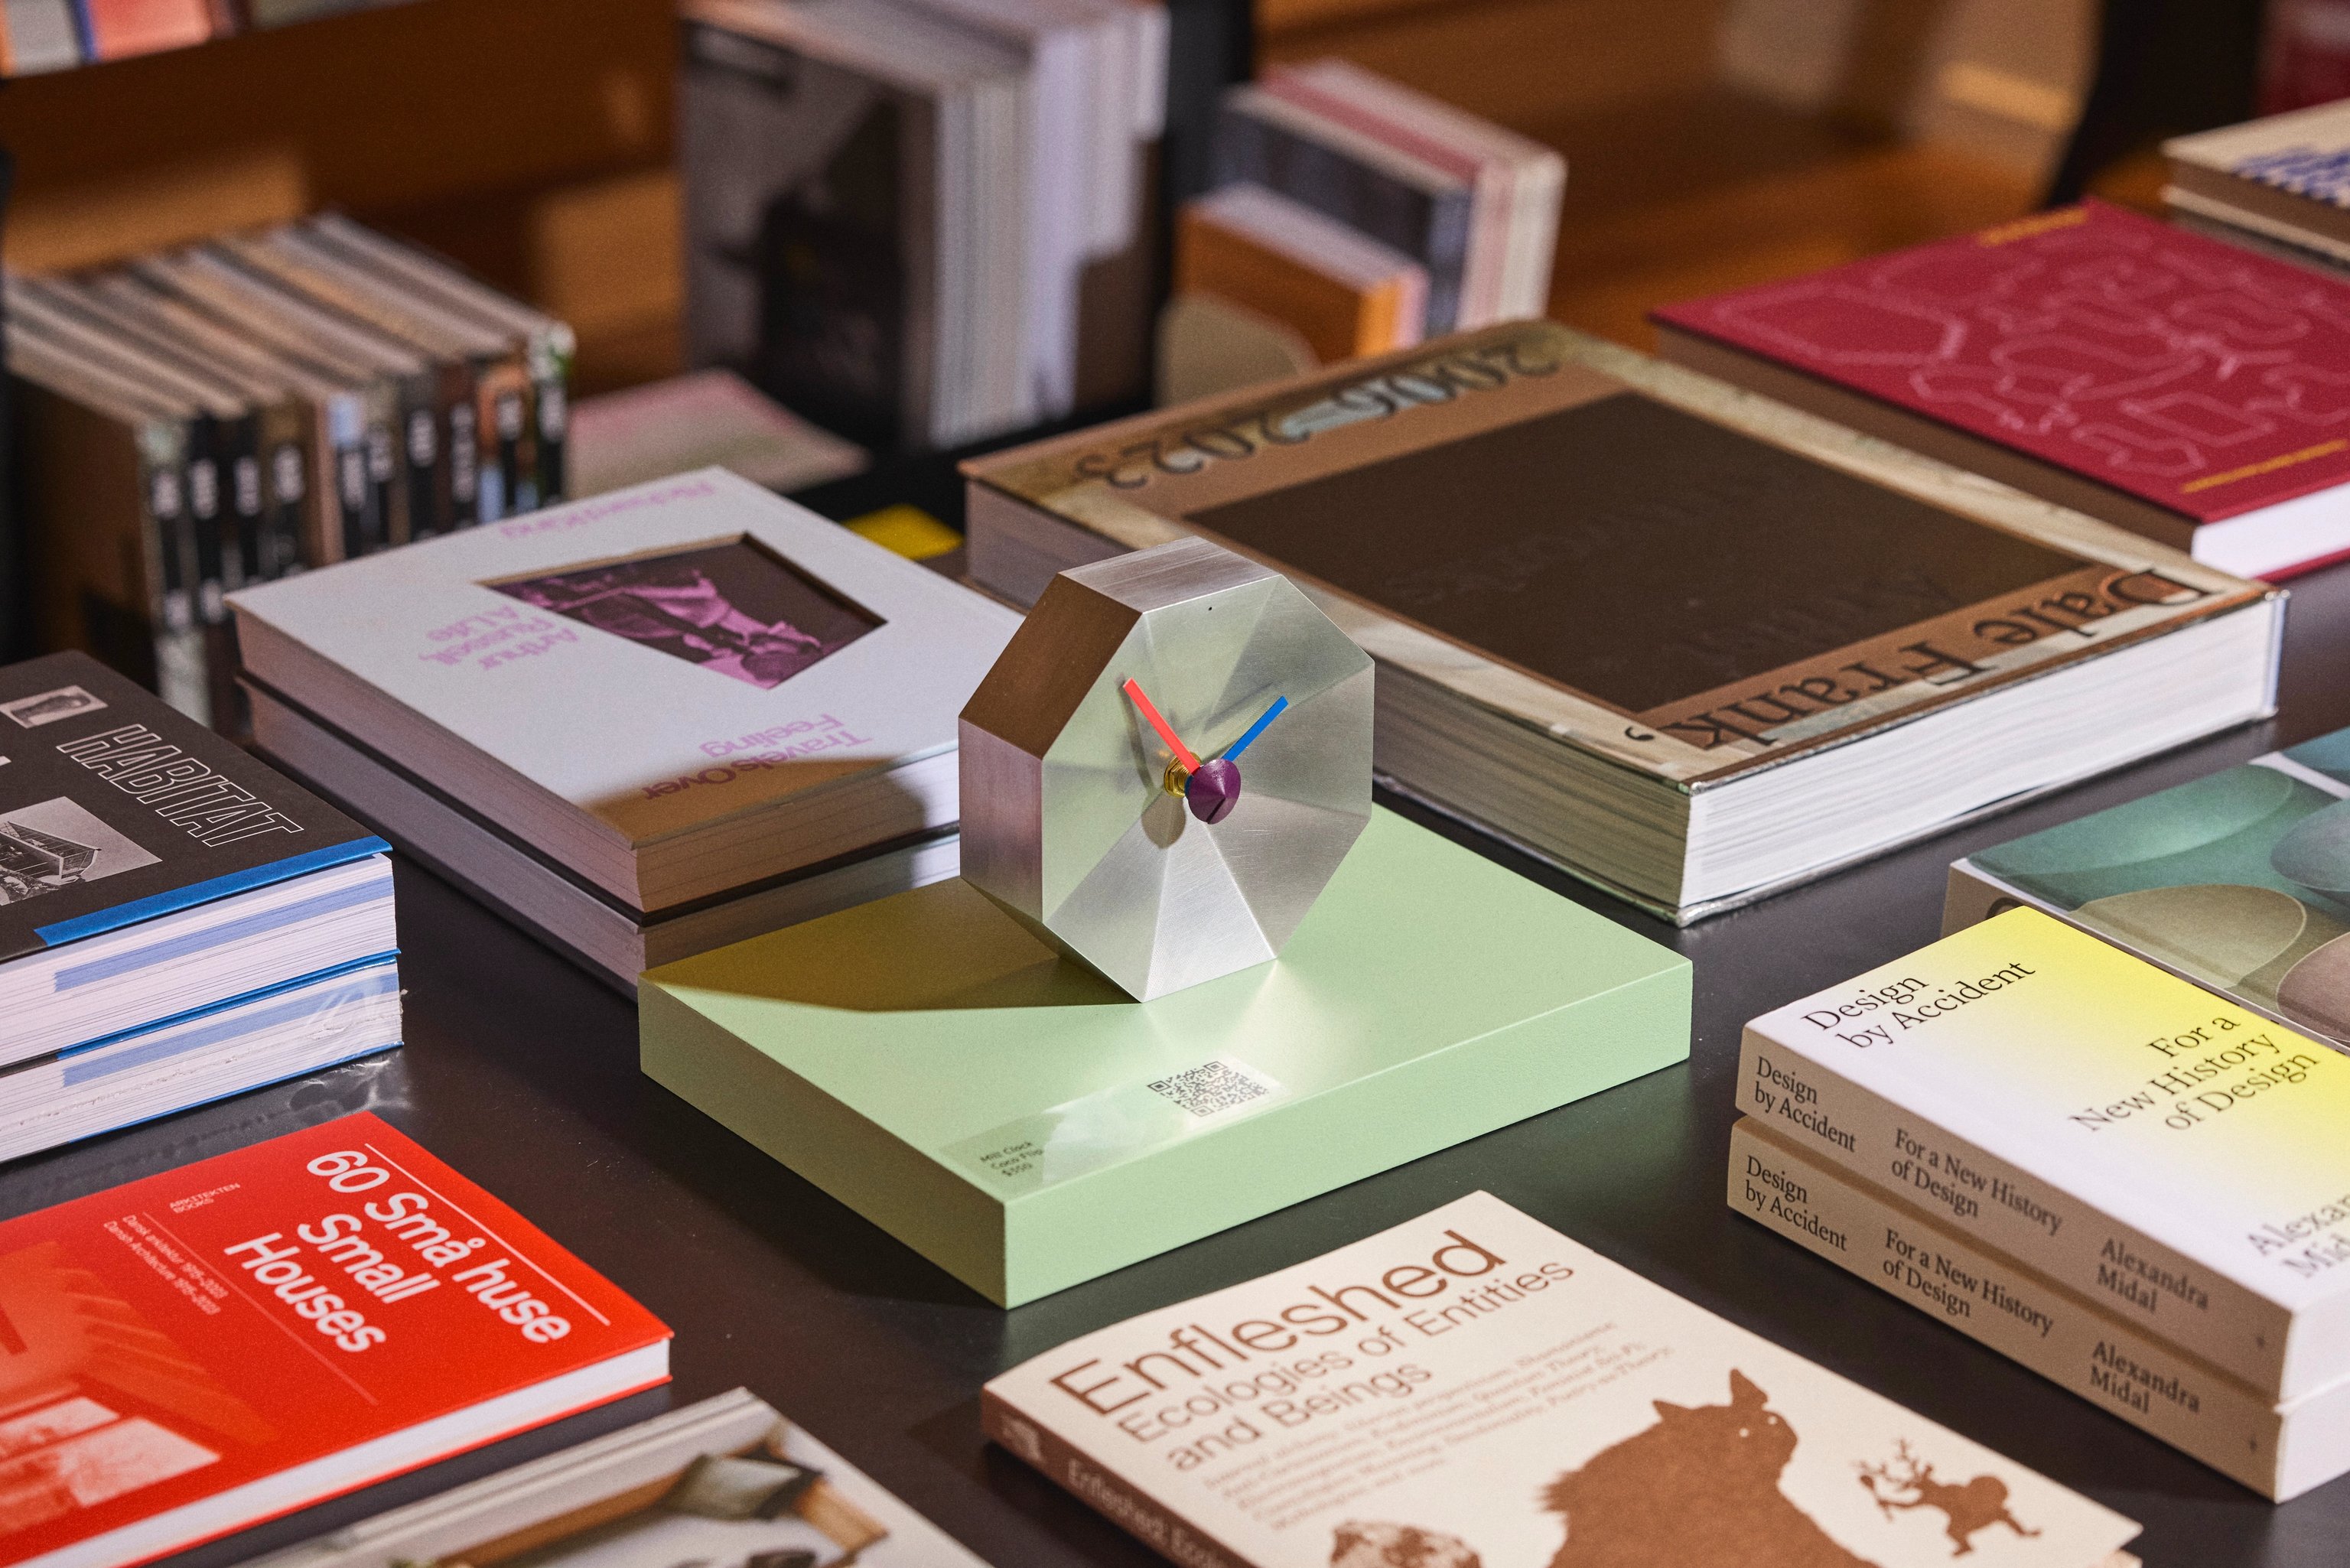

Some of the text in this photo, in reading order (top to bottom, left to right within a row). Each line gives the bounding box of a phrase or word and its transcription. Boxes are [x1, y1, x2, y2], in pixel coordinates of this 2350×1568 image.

[1624, 568, 2213, 749] Dale Frank,
[641, 730, 872, 801] Travels Over
[698, 713, 844, 759] Feeling
[56, 724, 304, 847] HABITAT
[1801, 973, 1929, 1033] Design
[1836, 959, 2036, 1050] by Accident
[2148, 1014, 2241, 1059] For a
[1757, 1056, 1818, 1105] Design
[2069, 1031, 2282, 1133] New History
[2164, 1051, 2320, 1130] of Design
[1753, 1085, 1856, 1153] by Accident
[170, 1183, 240, 1209] ARKITEKTEN
[1744, 1181, 1847, 1251] by Accident
[1746, 1156, 1808, 1205] Design
[1891, 1158, 1979, 1219] of Design
[1895, 1129, 2063, 1237] For a New History
[298, 1213, 441, 1304] Small
[307, 1150, 571, 1344] 60 Små huse
[1885, 1228, 2055, 1337] For a New History
[2101, 1239, 2208, 1310] Alexandra
[224, 1232, 386, 1352] Houses
[1049, 1228, 1508, 1417] Enfleshed
[1883, 1257, 1971, 1319] of Design
[2098, 1266, 2158, 1313] Midal
[1116, 1345, 1354, 1445] Ecologies
[1358, 1325, 1408, 1359] of
[1404, 1259, 1575, 1338] Entities
[2092, 1340, 2202, 1413] Alexandra
[1167, 1413, 1264, 1472] and
[1260, 1355, 1434, 1429] Beings
[2090, 1365, 2150, 1415] Midal
